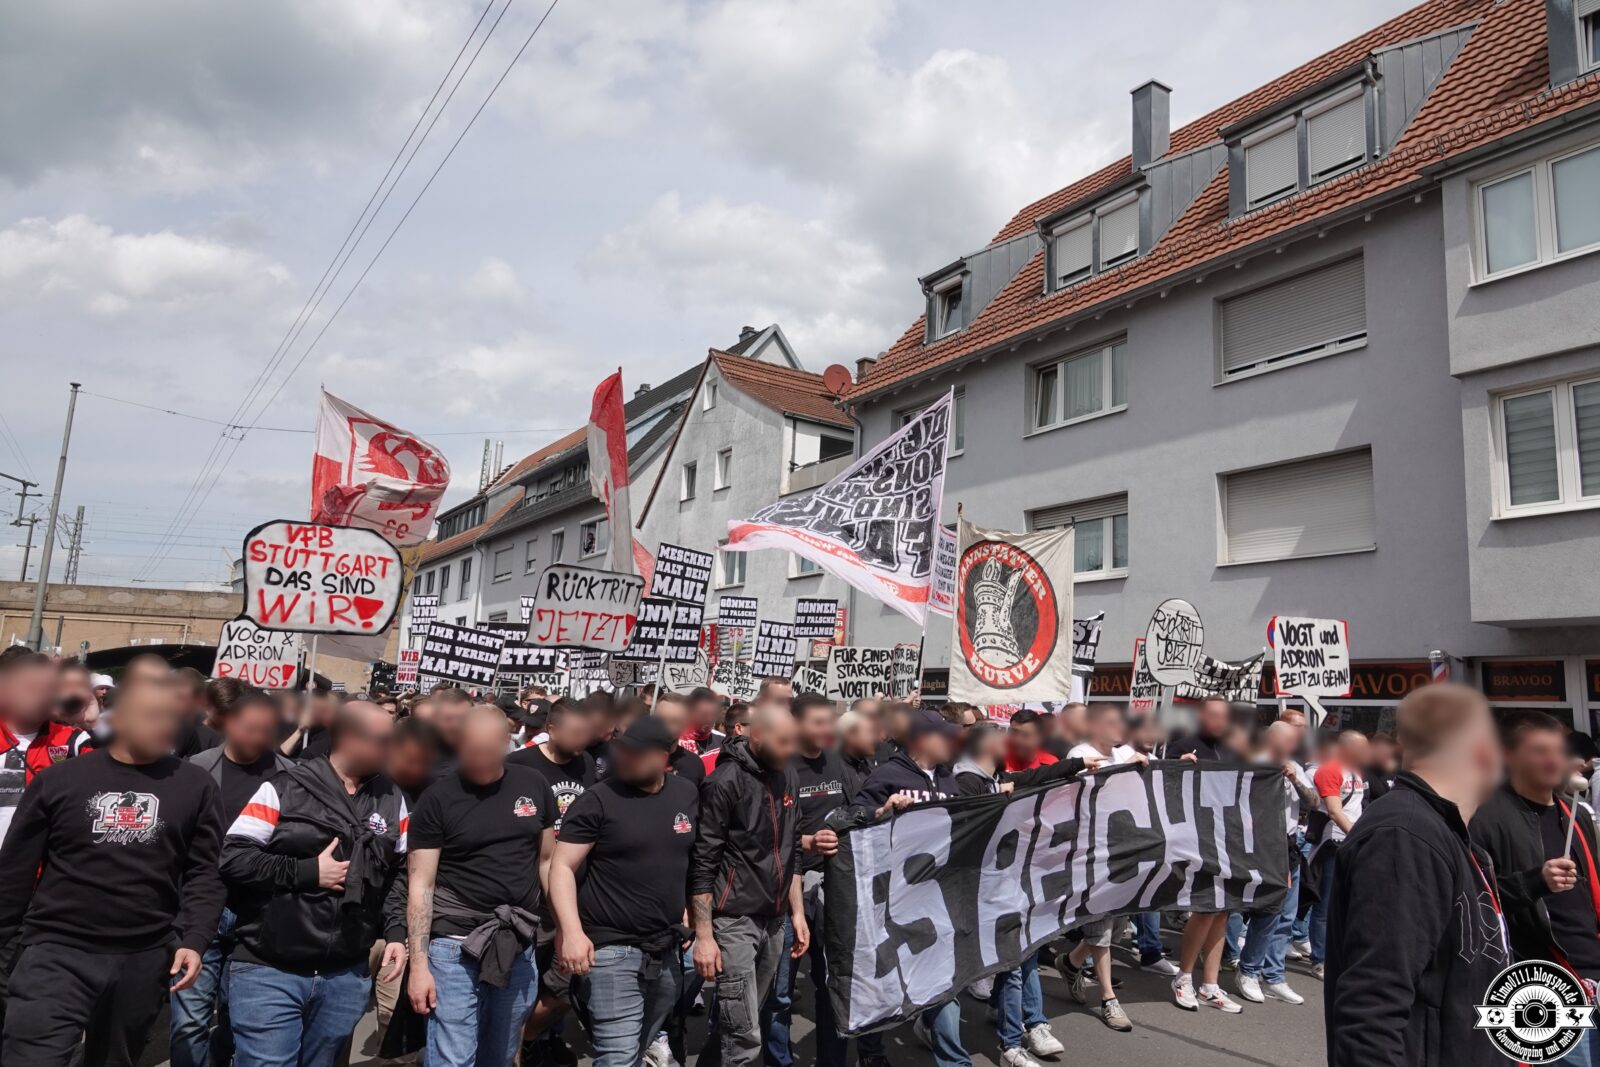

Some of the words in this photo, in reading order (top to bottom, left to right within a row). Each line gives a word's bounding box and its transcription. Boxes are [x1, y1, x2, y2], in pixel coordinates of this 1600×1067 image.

[249, 540, 394, 579] STUTTGART
[659, 545, 713, 569] MESCHKE
[264, 567, 312, 591] DAS
[656, 560, 684, 576] HALT
[684, 566, 710, 582] DEIN
[958, 544, 1048, 601] CANNSTATTER
[651, 573, 706, 603] MAUL
[413, 596, 438, 606] VOGT
[720, 598, 757, 610] GÖNNER
[797, 601, 837, 614] GÖNNER
[413, 606, 438, 617] UND
[637, 601, 702, 625] ÖNNER
[729, 609, 757, 617] FALSCHE
[796, 615, 805, 624] DU
[806, 616, 836, 625] FALSCHE
[411, 624, 430, 634] RAU
[536, 608, 637, 647] JETZT!
[719, 617, 756, 627] SCHLANGE
[794, 626, 834, 636] SCHLANGE
[282, 631, 294, 647] &
[429, 625, 455, 640] IHR
[457, 630, 504, 650] MACHT
[1279, 621, 1316, 647] VOGT
[1319, 625, 1340, 646] und
[425, 640, 452, 655] DEN
[454, 646, 499, 664] VEREIN
[614, 643, 697, 660] CHLANGE
[758, 637, 796, 655] UND
[500, 647, 555, 666] ETZT
[756, 653, 794, 664] ADRION
[861, 649, 894, 664] EINEN
[1280, 648, 1326, 670] ADRION
[218, 662, 296, 688] RAUS!
[397, 672, 416, 682] WIR
[420, 655, 496, 682] KAPUTT
[753, 662, 793, 679] RAUS
[836, 663, 884, 679] STARKEN
[969, 652, 1041, 686] KURVE
[1280, 671, 1308, 690] ZEIT
[1322, 668, 1349, 688] GEHN!
[1493, 674, 1553, 687] BRAVOO
[849, 806, 956, 1030] ES
[978, 768, 1263, 968] REICHT!
